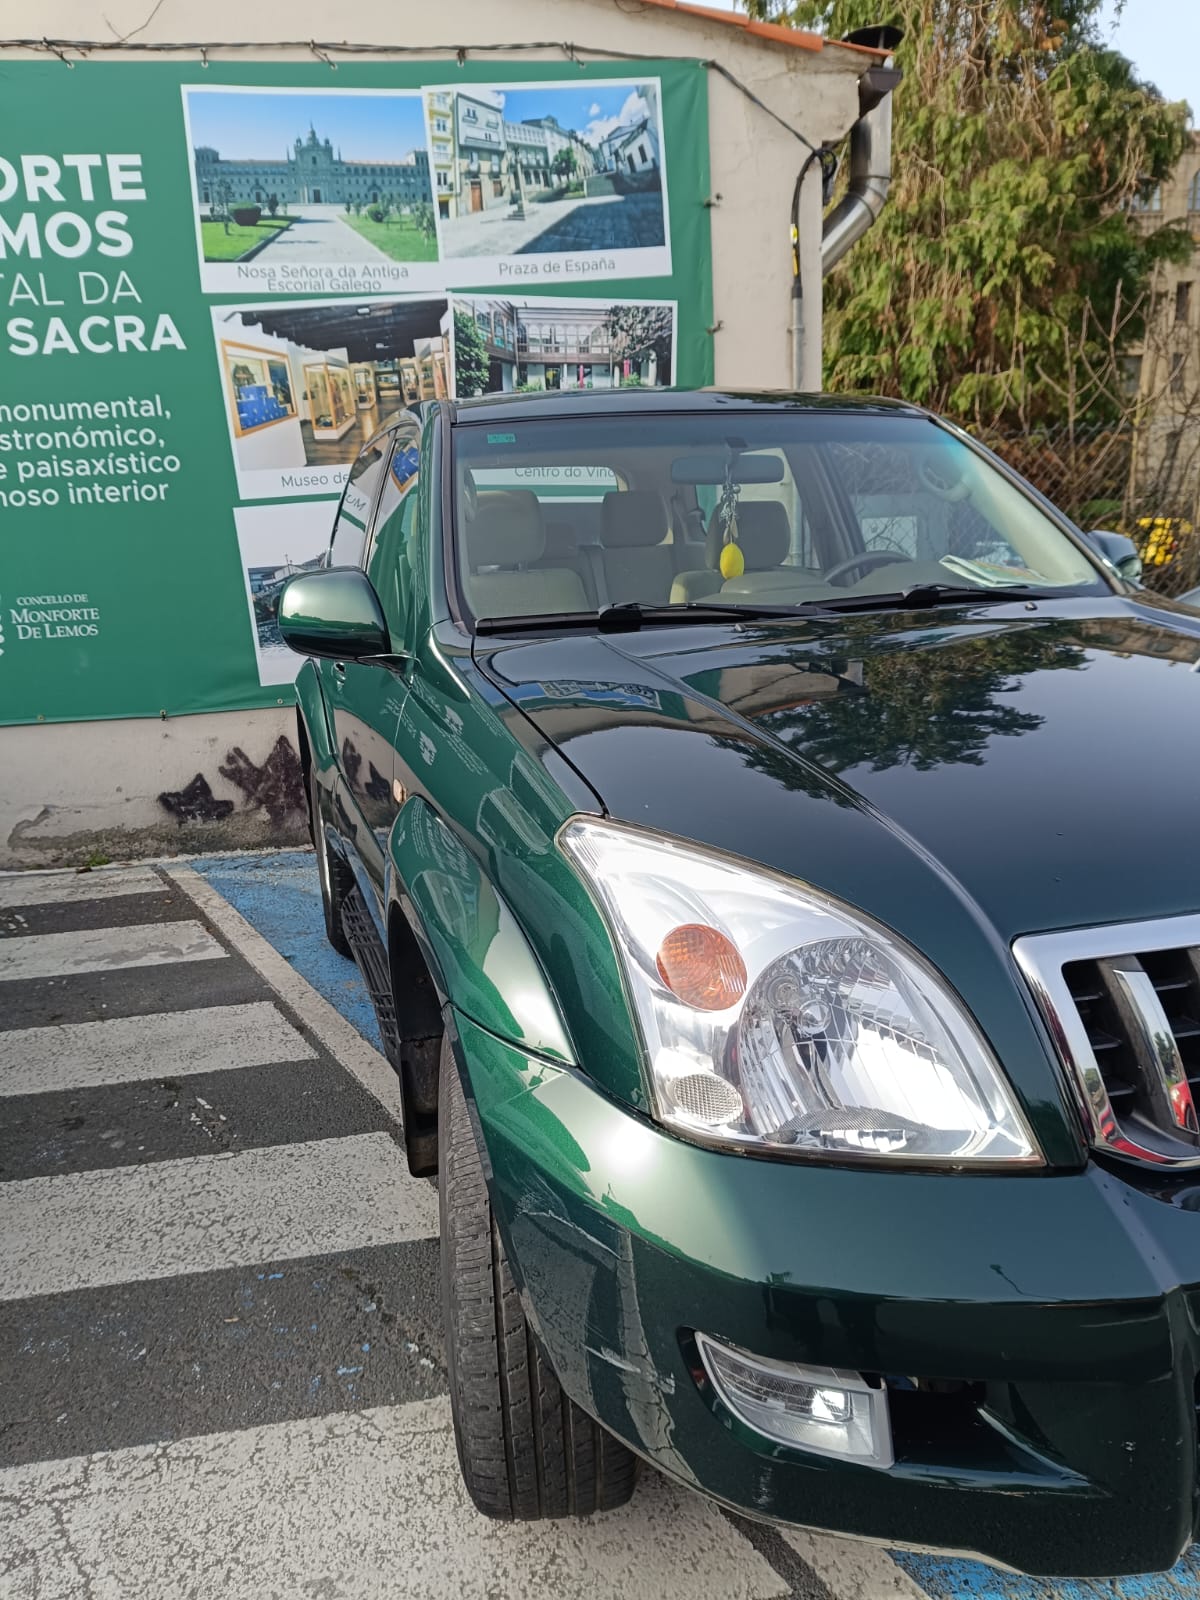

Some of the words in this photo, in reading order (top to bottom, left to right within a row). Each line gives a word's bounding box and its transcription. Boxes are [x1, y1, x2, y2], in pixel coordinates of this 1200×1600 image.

[0, 210, 134, 259] MOS
[237, 264, 276, 279] Nosa
[281, 264, 333, 279] Señora
[336, 264, 357, 279] da
[360, 264, 409, 281] Antiga
[498, 262, 538, 277] Praza
[542, 260, 561, 273] de
[565, 257, 616, 274] España
[0, 272, 65, 307] AL
[78, 270, 143, 306] DA
[267, 278, 326, 294] Escorial
[329, 277, 382, 294] Galego
[6, 313, 188, 357] SACRA
[0, 424, 165, 452] stronómico,
[16, 451, 182, 484] paisaxístico
[514, 466, 560, 479] Centro
[564, 466, 582, 478] do
[66, 479, 169, 505] interior
[281, 475, 329, 488] Museo
[16, 593, 73, 606] CONCELLO
[73, 593, 89, 604] DE
